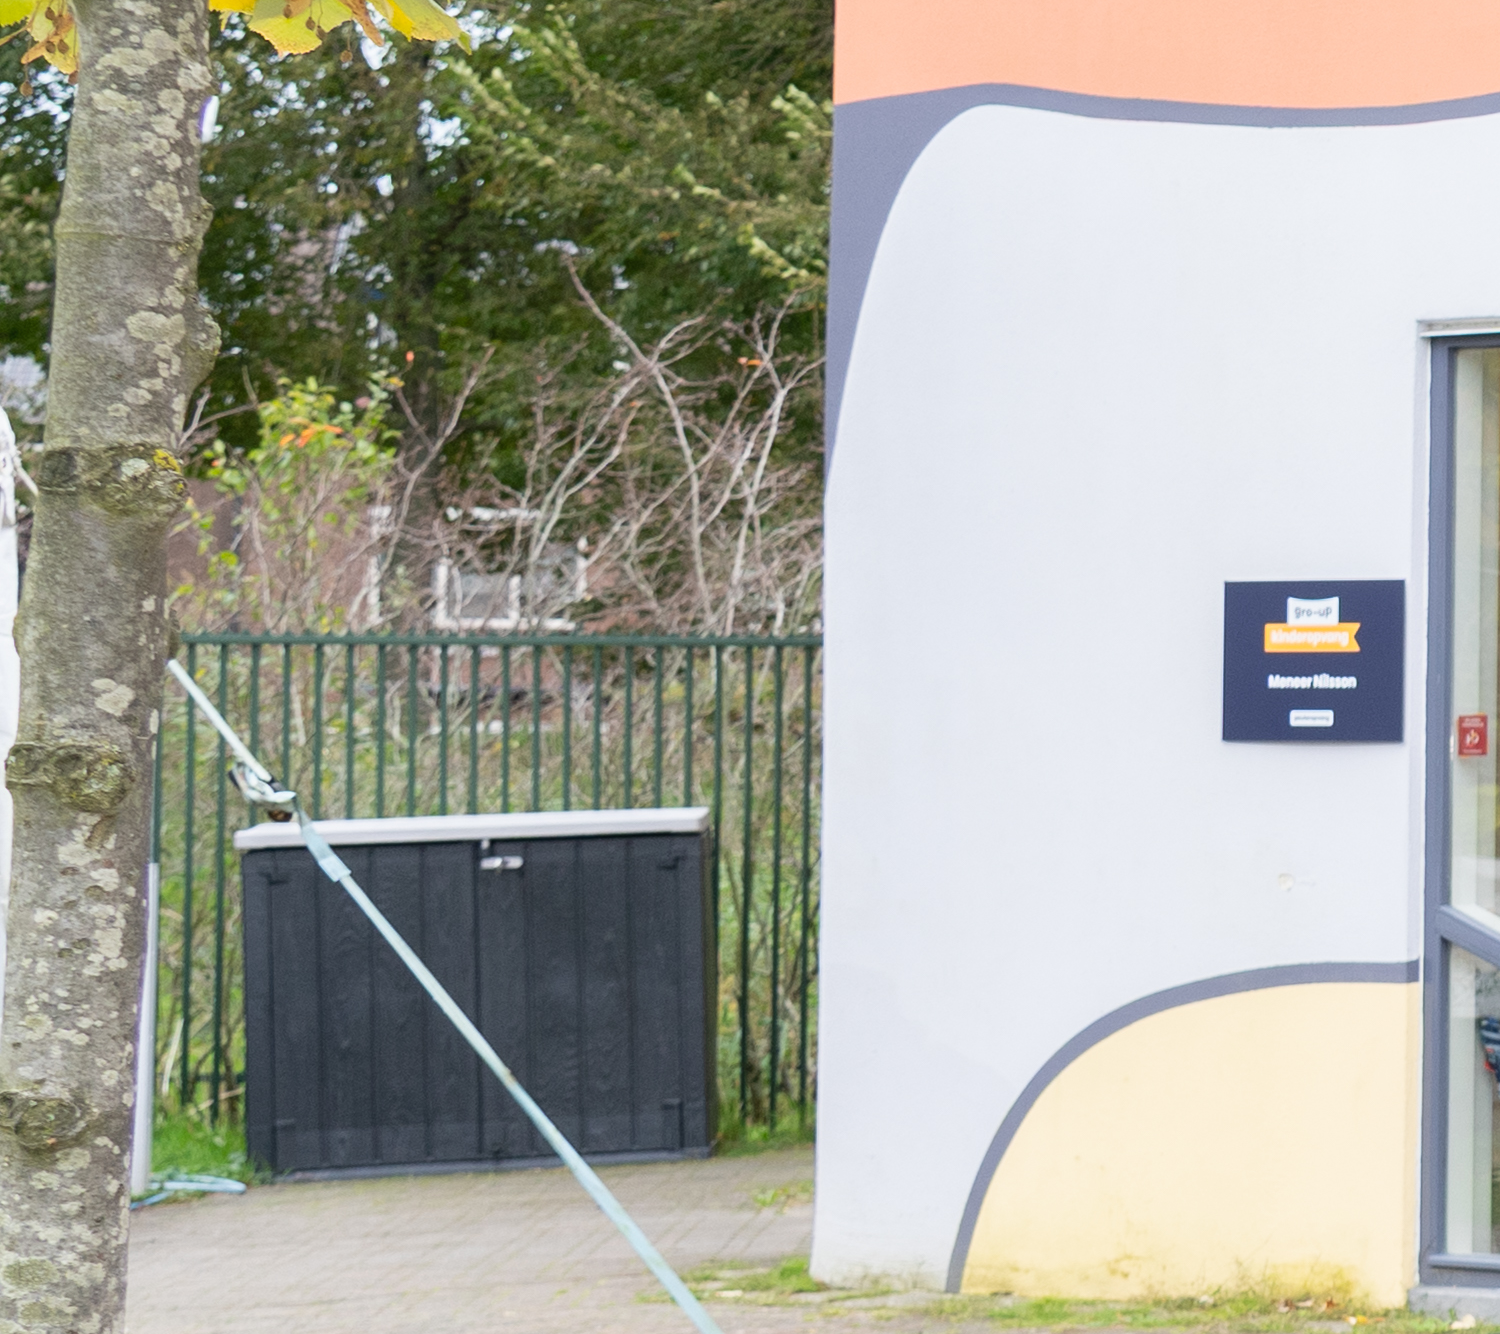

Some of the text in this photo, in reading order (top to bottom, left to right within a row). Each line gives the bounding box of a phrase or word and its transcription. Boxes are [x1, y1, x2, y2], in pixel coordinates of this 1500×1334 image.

[1295, 607, 1332, 619] gro-up
[1271, 629, 1349, 647] kinderopvang
[1268, 672, 1358, 689] Meneer Nilsson
